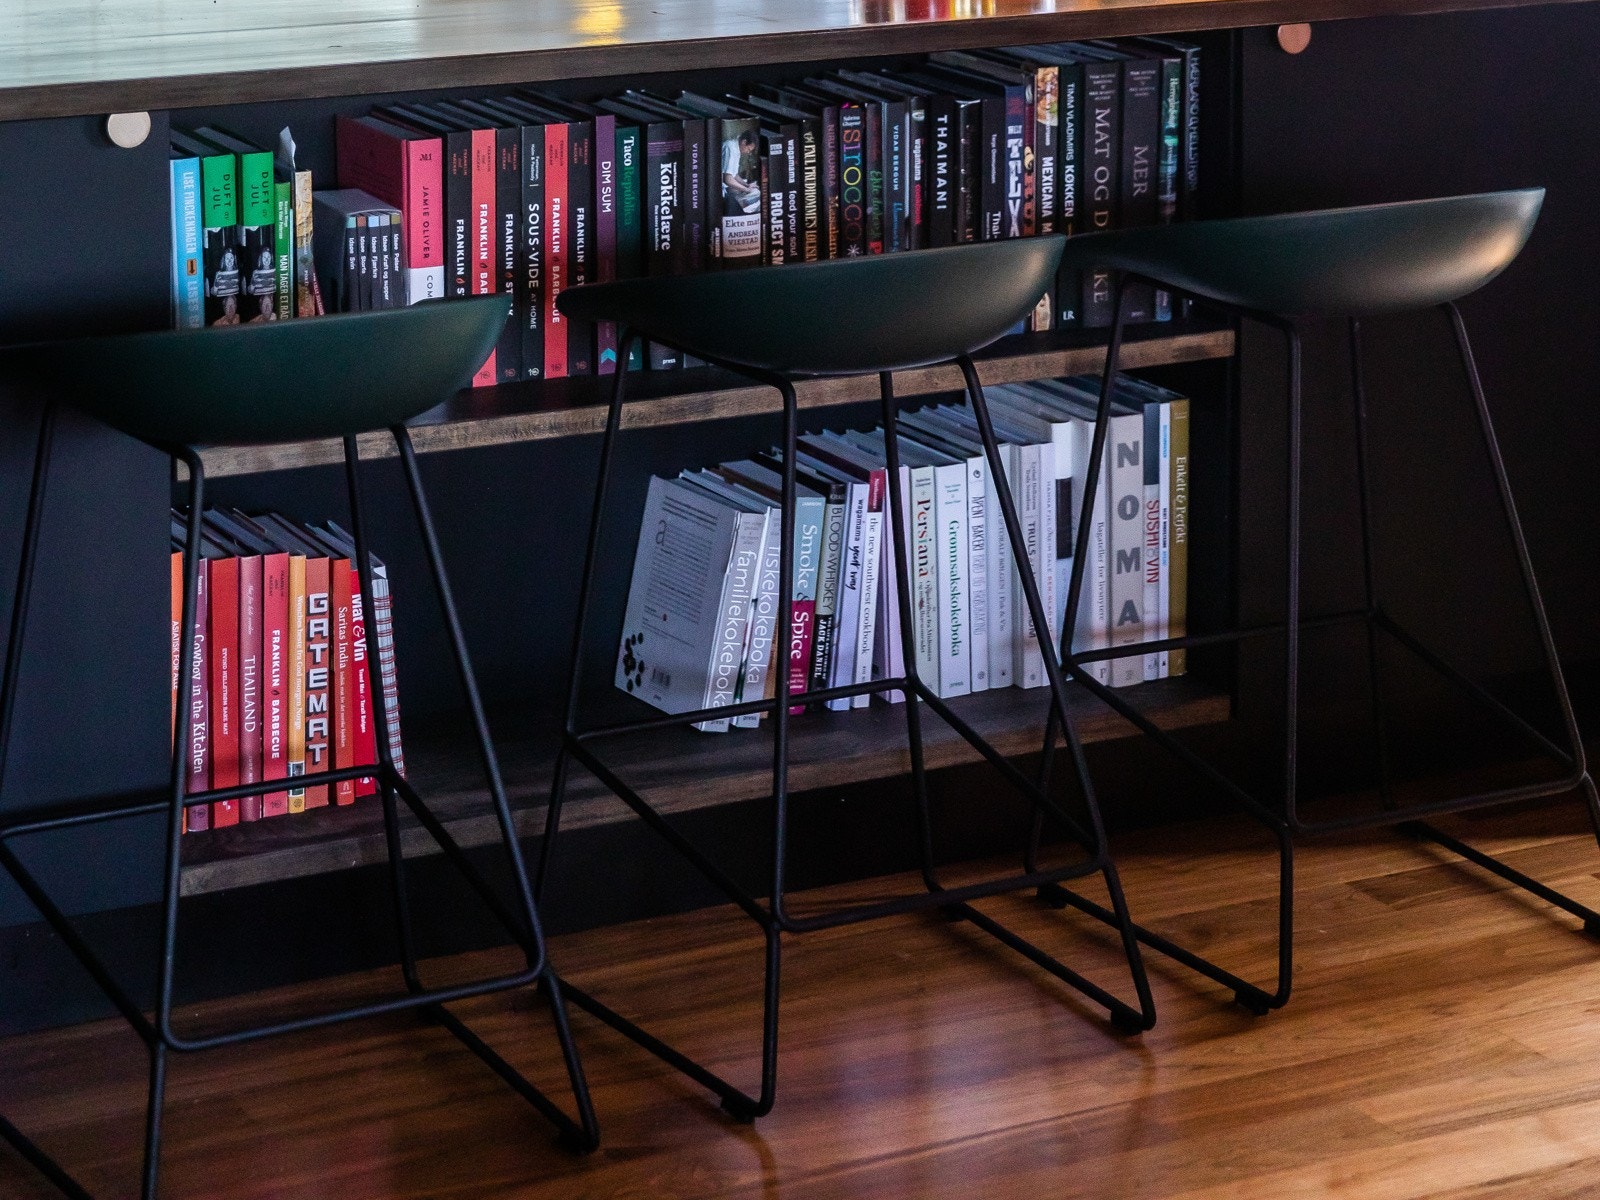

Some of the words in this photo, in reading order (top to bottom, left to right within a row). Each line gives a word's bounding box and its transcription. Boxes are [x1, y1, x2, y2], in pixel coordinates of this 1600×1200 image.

[1065, 83, 1075, 108] TIMM
[892, 124, 900, 151] VIDAR
[1065, 110, 1075, 161] VLADIMIRS
[1094, 107, 1111, 158] MAT
[623, 136, 635, 167] Taco
[787, 139, 796, 183] wagamama
[804, 144, 816, 166] PAUL
[828, 151, 836, 188] KUMRA
[913, 138, 922, 181] wagamama
[936, 114, 948, 210] THAIMANI
[183, 171, 195, 189] LISE
[261, 170, 270, 204] DUFT
[601, 160, 612, 184] DIM
[892, 154, 900, 191] BERGUM
[1041, 156, 1054, 218] MEXICANA
[1094, 165, 1111, 201] OG
[1131, 145, 1149, 197] MER
[213, 187, 221, 211] JUL
[223, 173, 232, 208] DUFT
[251, 183, 259, 208] JUL
[422, 185, 430, 217] JAMIE
[601, 186, 612, 213] SUM
[660, 162, 673, 251] Kokkelære
[789, 190, 797, 211] feed
[1064, 164, 1075, 217] KØKKEN
[185, 191, 198, 254] FINCKENHAGEN
[479, 203, 488, 260] FRANKLIN
[552, 198, 561, 253] FRANKLIN
[576, 207, 585, 263] FRANKLIN
[728, 230, 759, 238] ANDREAS
[770, 192, 783, 245] PROJECT
[787, 213, 797, 234] your
[422, 220, 431, 260] OLIVER
[456, 219, 465, 276] FRANKLIN
[505, 213, 514, 270] FRANKLIN
[279, 254, 289, 271] MAN
[279, 272, 290, 294] TAGER
[280, 295, 290, 304] ET
[529, 305, 537, 330] HOME
[1175, 456, 1187, 492] Enkelt
[828, 507, 843, 552] BLOOD
[854, 499, 865, 542] wagamama
[869, 517, 878, 531] the
[916, 498, 933, 578] Persiana
[971, 525, 985, 551] BAKERI
[1028, 521, 1037, 556] TRULS
[1116, 441, 1142, 628] NOMA
[1145, 499, 1160, 547] SUSHI
[1174, 506, 1187, 544] Perfekt
[796, 524, 818, 589] Smoke
[868, 535, 876, 556] new
[821, 558, 839, 611] WHISKEY
[864, 558, 875, 605] southwest
[1097, 566, 1105, 578] for
[1145, 558, 1160, 584] VIN
[171, 620, 180, 653] ASIATISK
[338, 606, 348, 640] Saritas
[711, 549, 757, 709] familiekokeboka
[790, 611, 809, 660] Spice
[817, 620, 827, 642] JACK
[861, 606, 873, 655] cookbook
[171, 654, 180, 670] FOR
[271, 630, 281, 687] FRANKLIN
[338, 641, 349, 669] India
[353, 637, 368, 661] Vin
[815, 644, 824, 678] DANIEL
[192, 684, 203, 697] in
[244, 655, 256, 733] THAILAND
[307, 593, 329, 766] GATEMAT
[192, 700, 204, 719] the
[271, 699, 280, 759] BARBECUE
[192, 722, 207, 774] Kitchen
